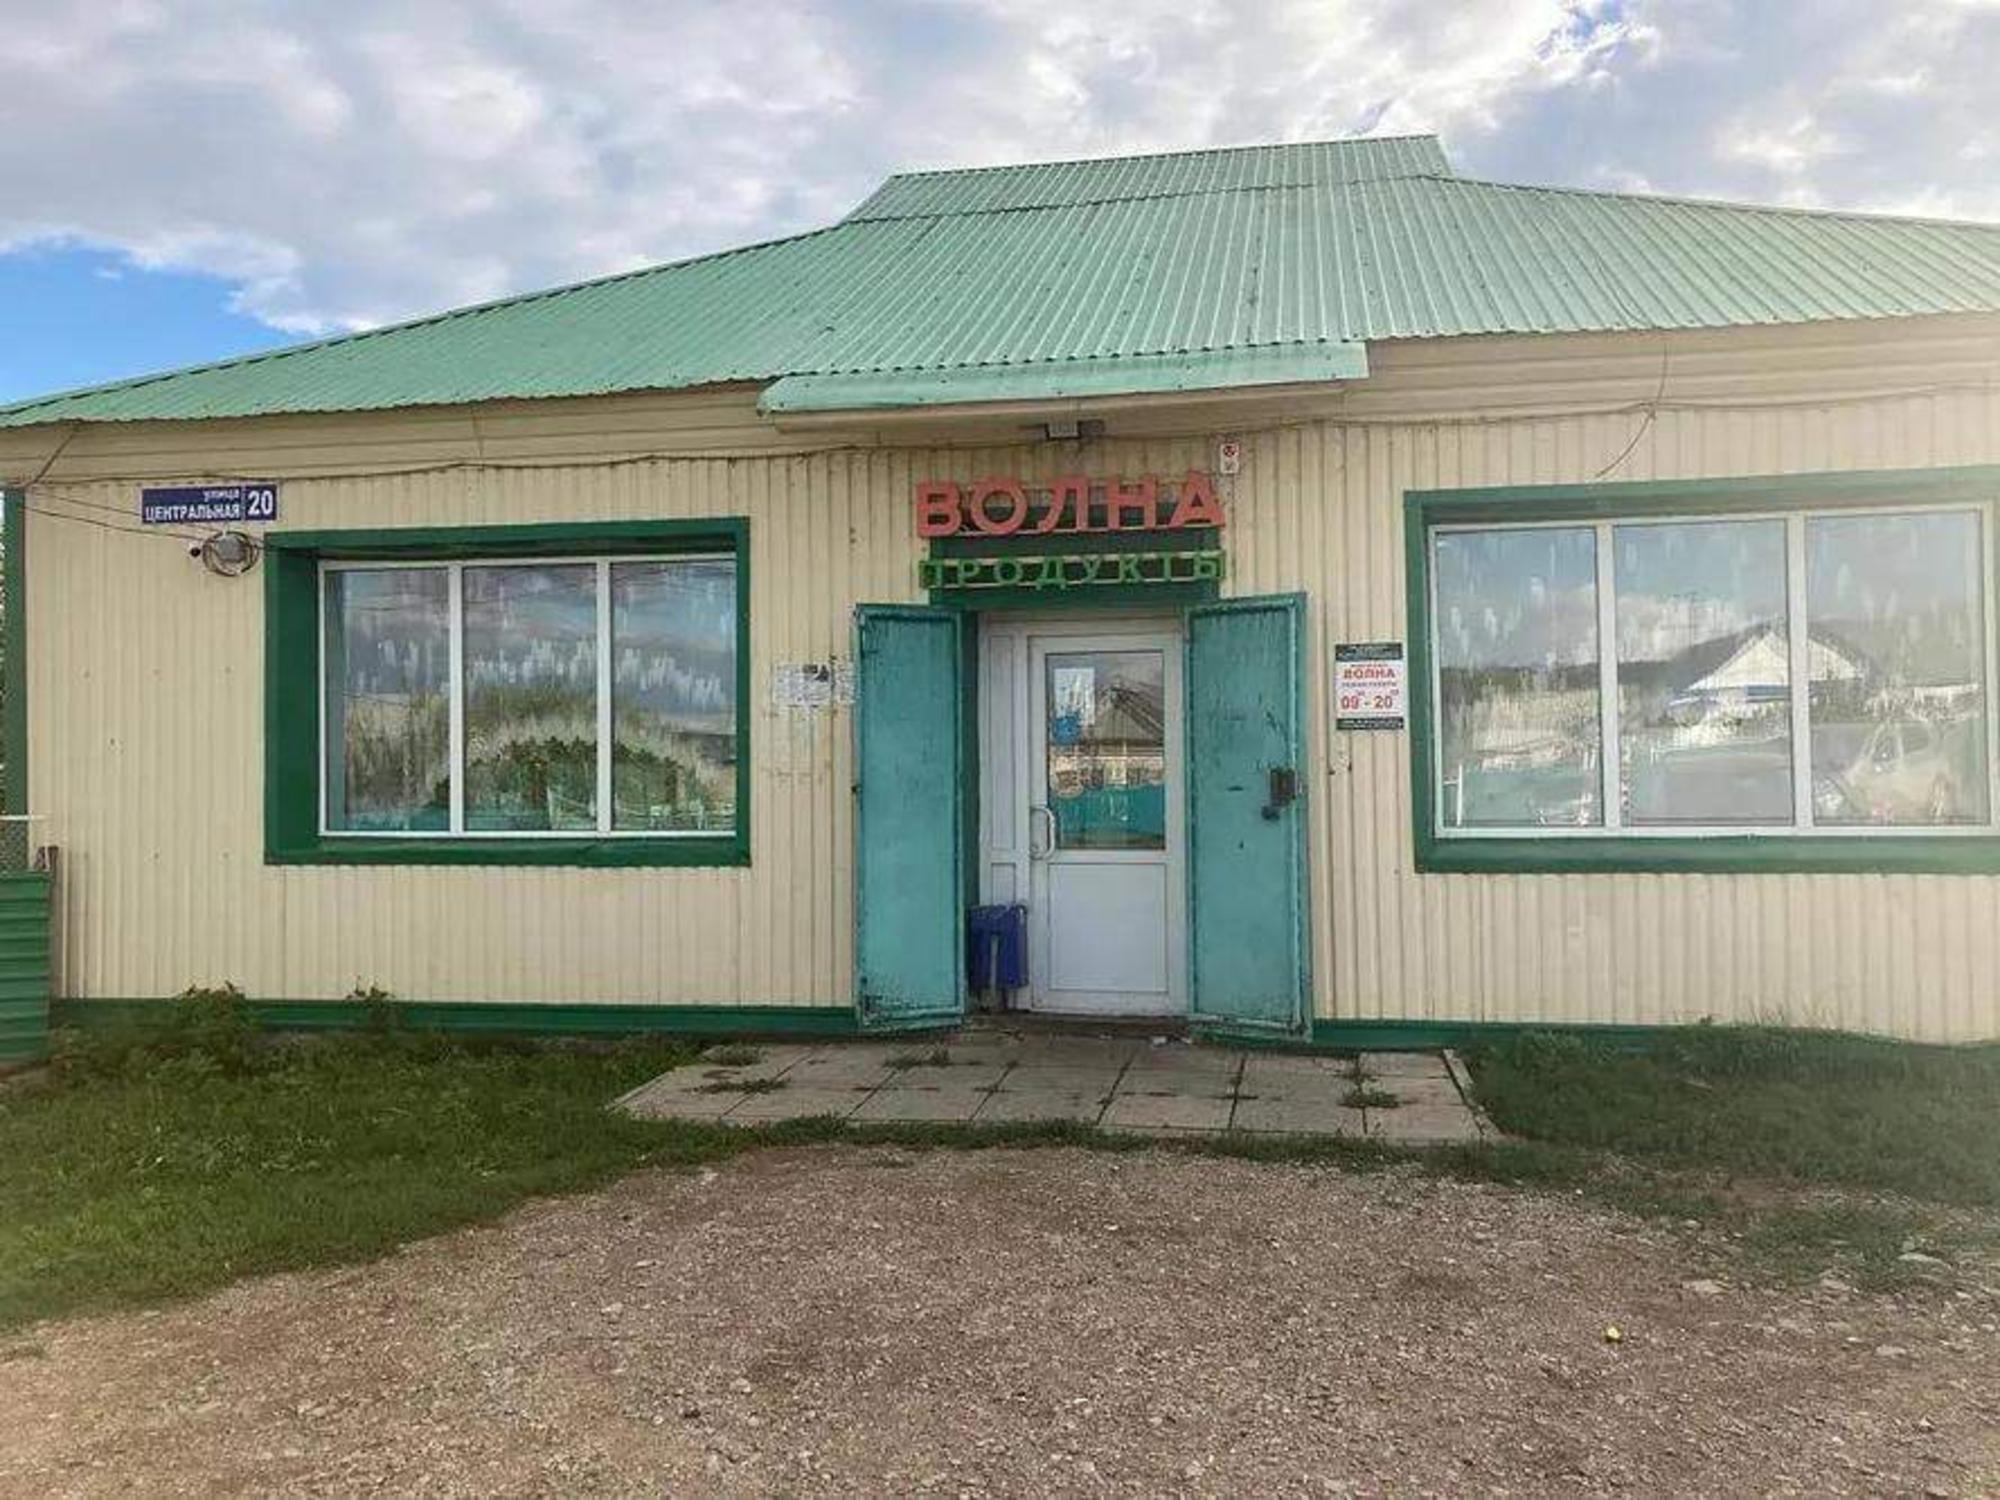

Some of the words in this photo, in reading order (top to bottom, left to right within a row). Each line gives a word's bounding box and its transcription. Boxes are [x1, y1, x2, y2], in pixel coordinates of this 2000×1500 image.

[145, 504, 241, 521] ЦЕНТРАЛЬНАЯ
[247, 490, 273, 516] 20
[915, 470, 1226, 538] ВОЛНА
[918, 549, 1227, 591] ПРОДУКТЫ
[1373, 695, 1393, 709] 20
